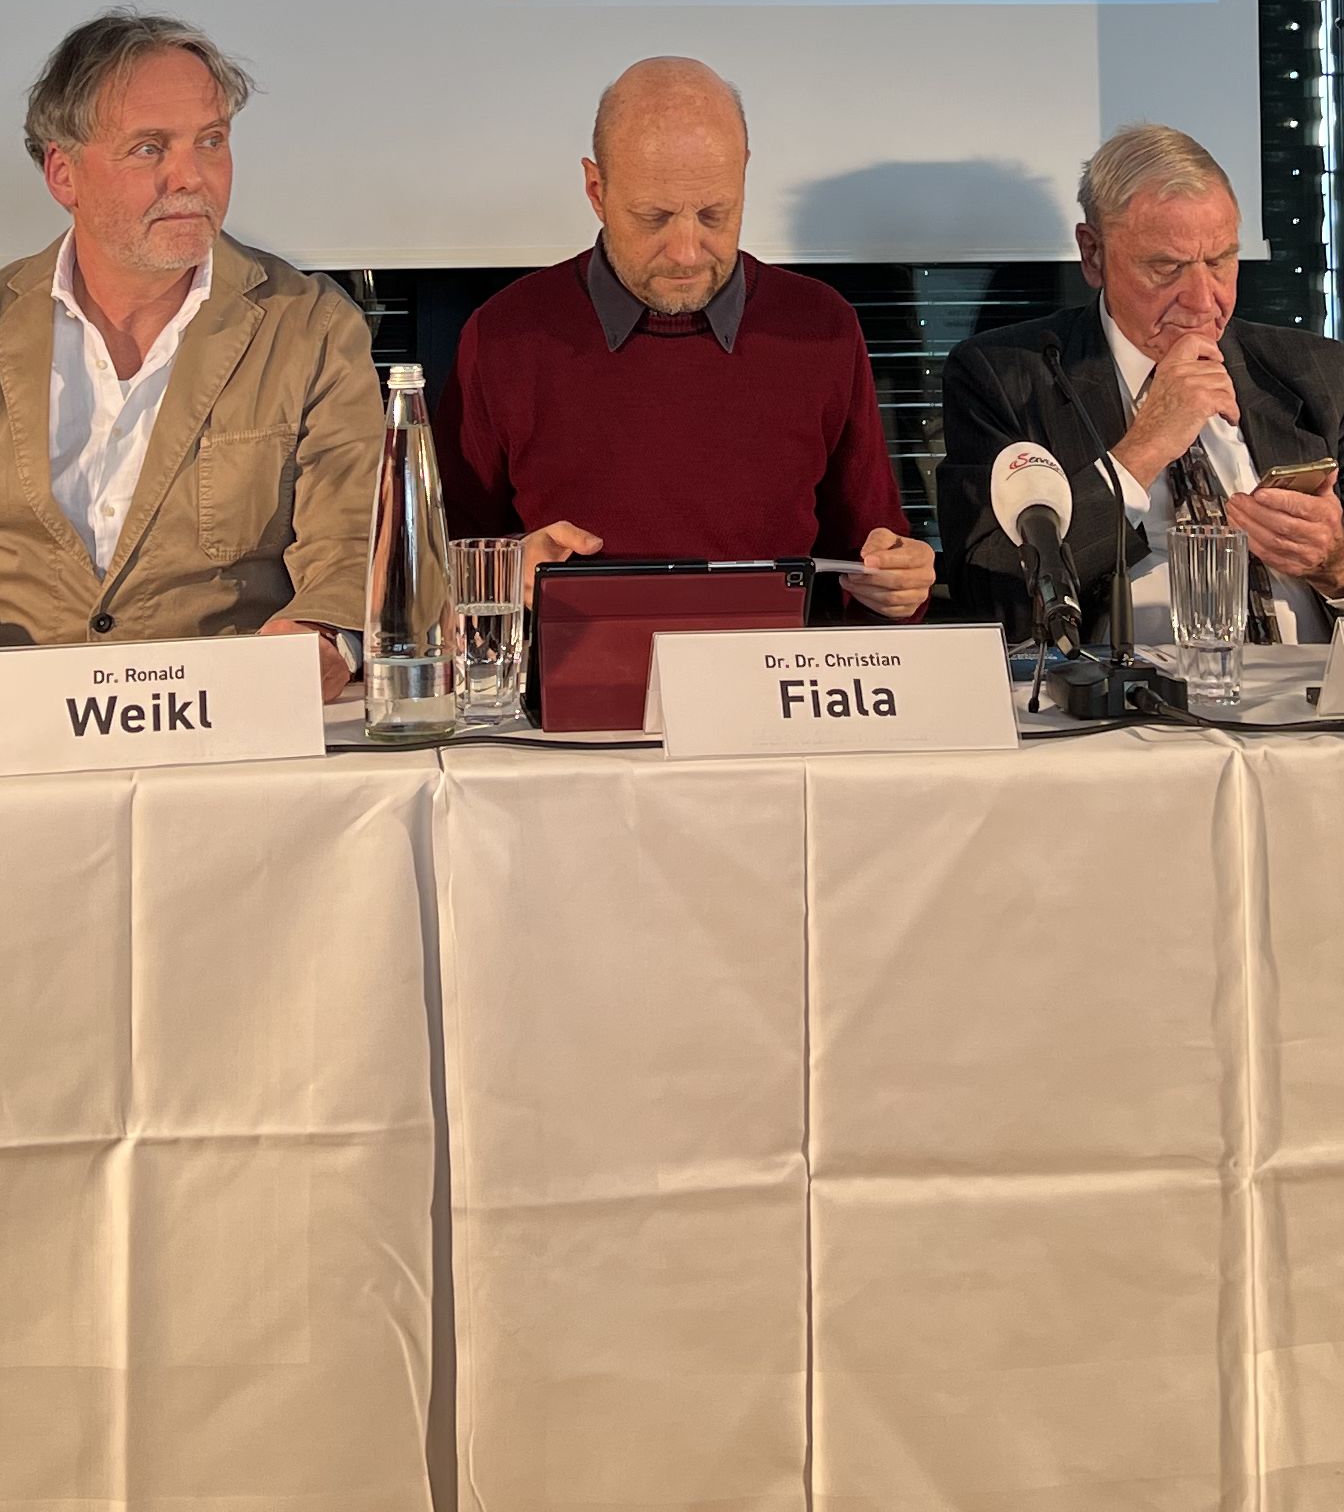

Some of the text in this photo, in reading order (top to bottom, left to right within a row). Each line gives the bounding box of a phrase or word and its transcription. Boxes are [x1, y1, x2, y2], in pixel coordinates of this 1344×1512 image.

[92, 664, 185, 685] Dr. Ronald
[764, 652, 901, 669] Dr. Dr. Christian
[65, 689, 213, 737] Weikl
[779, 678, 897, 719] Fiala
